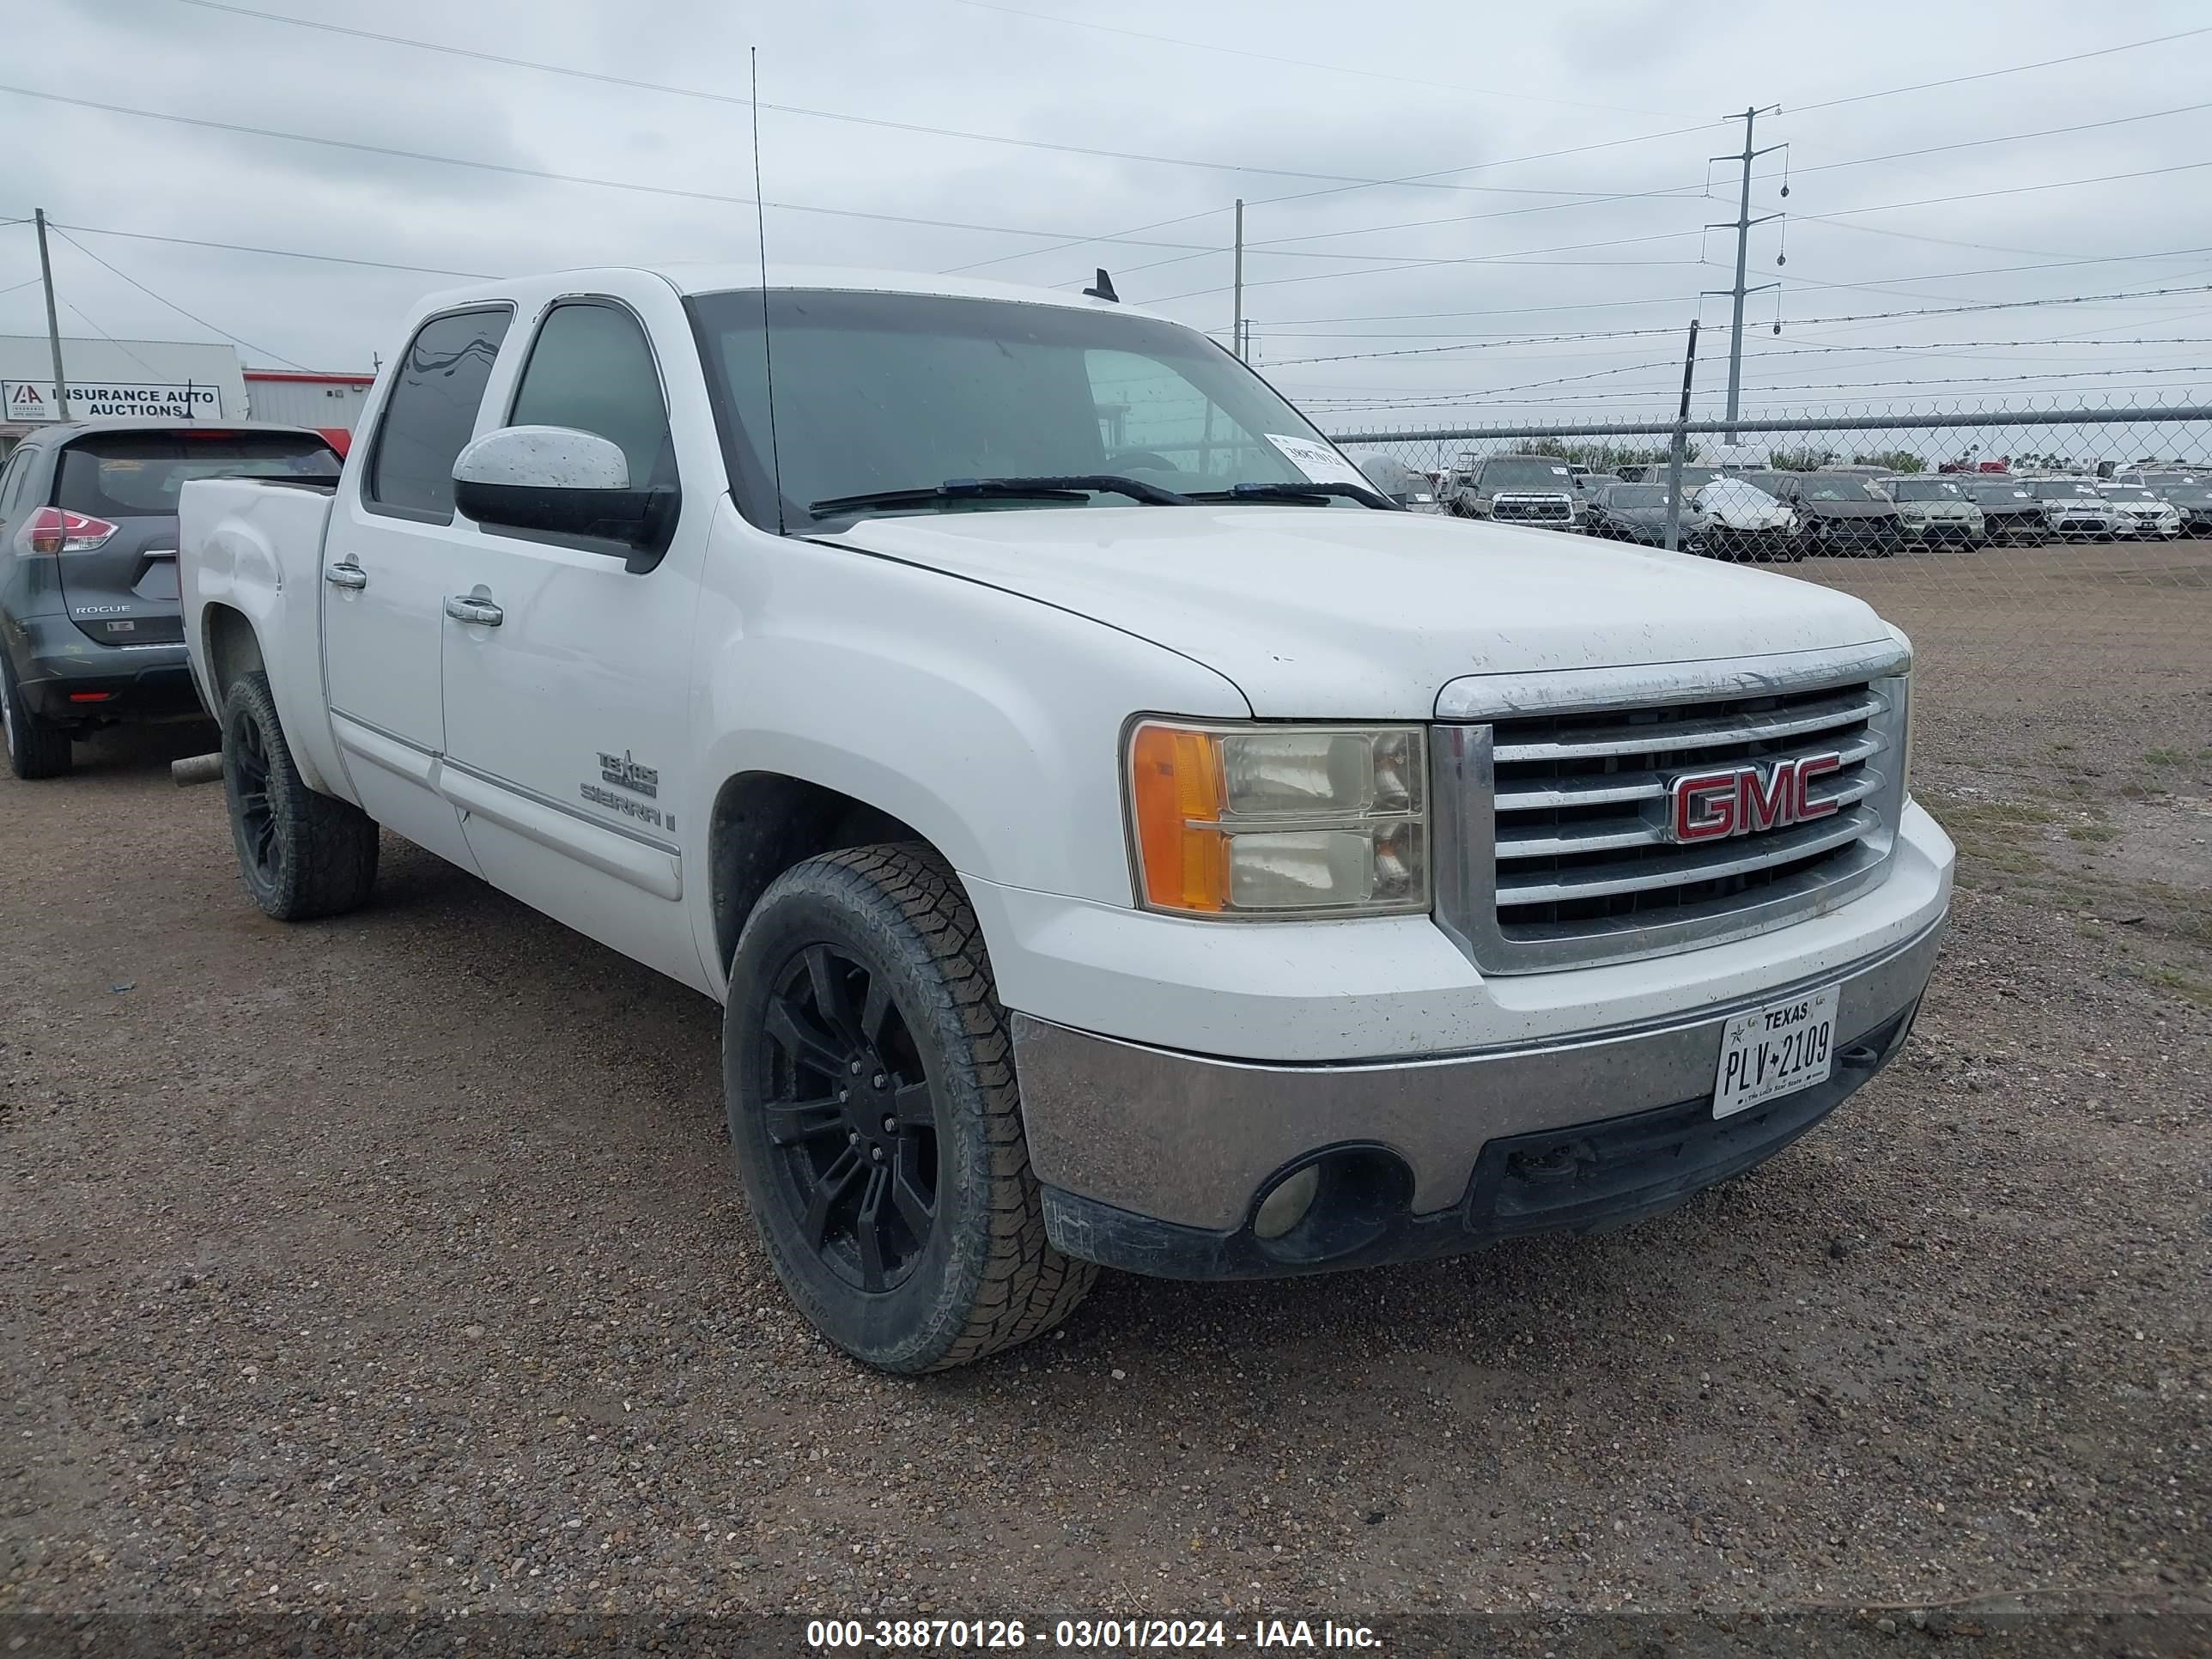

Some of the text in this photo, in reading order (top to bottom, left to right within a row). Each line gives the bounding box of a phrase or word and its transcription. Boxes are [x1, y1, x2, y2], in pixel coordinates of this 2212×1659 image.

[52, 388, 214, 403] ISURANCE AUTO
[89, 404, 183, 416] AUCTIONS
[76, 605, 131, 615] ROGUE
[580, 782, 661, 827] SIERRA
[1672, 750, 1840, 845] GMC
[1765, 1002, 1808, 1030] TEXAS
